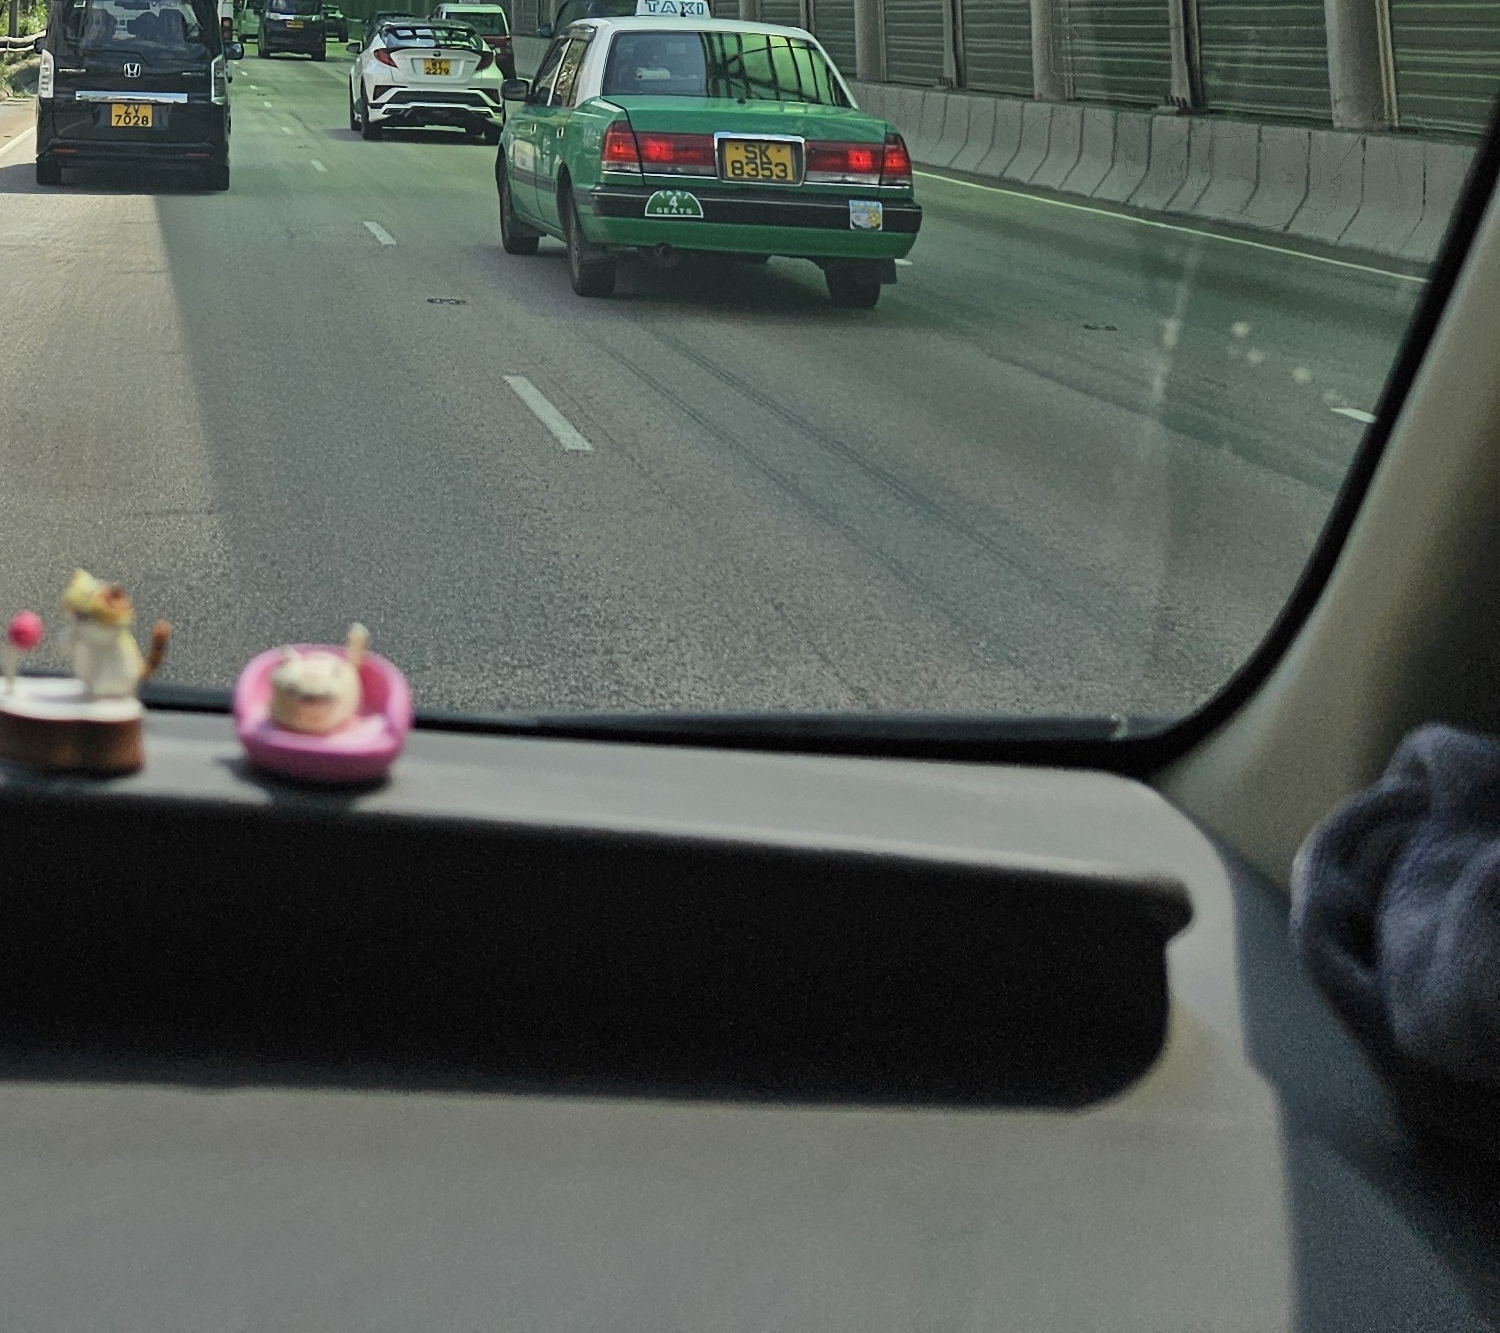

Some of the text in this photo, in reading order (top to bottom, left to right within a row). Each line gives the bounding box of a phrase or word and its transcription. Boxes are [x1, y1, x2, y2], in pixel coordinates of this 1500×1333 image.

[645, 0, 704, 15] TAXI
[115, 115, 149, 126] 7028
[743, 143, 773, 165] SK
[731, 159, 788, 180] 8353
[669, 196, 679, 209] 4
[656, 206, 693, 215] SEATS
